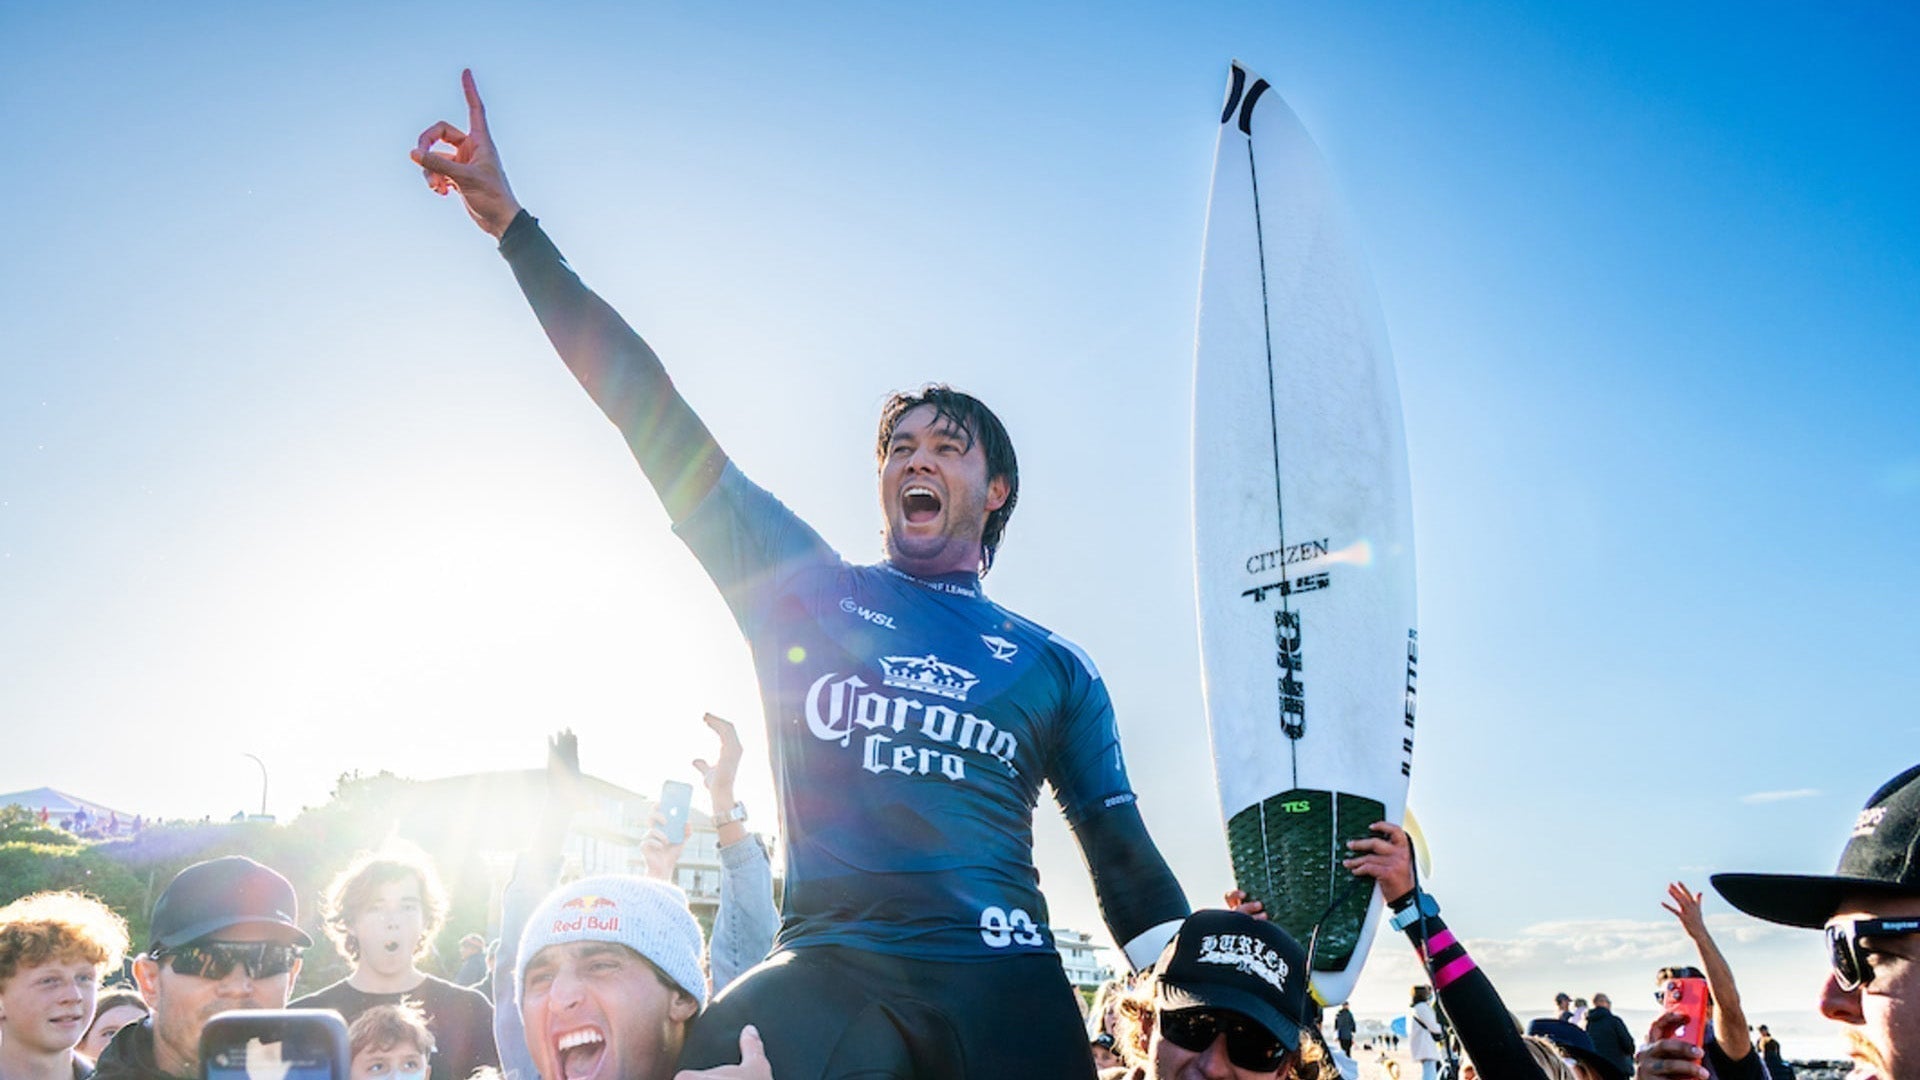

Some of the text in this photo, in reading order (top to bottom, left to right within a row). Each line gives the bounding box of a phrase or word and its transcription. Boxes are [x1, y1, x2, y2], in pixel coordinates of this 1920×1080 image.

[1246, 538, 1329, 574] CITIZEN
[858, 606, 897, 630] WSL
[805, 672, 1020, 779] Corona
[862, 733, 966, 781] Cero
[552, 915, 619, 934] Red Bull
